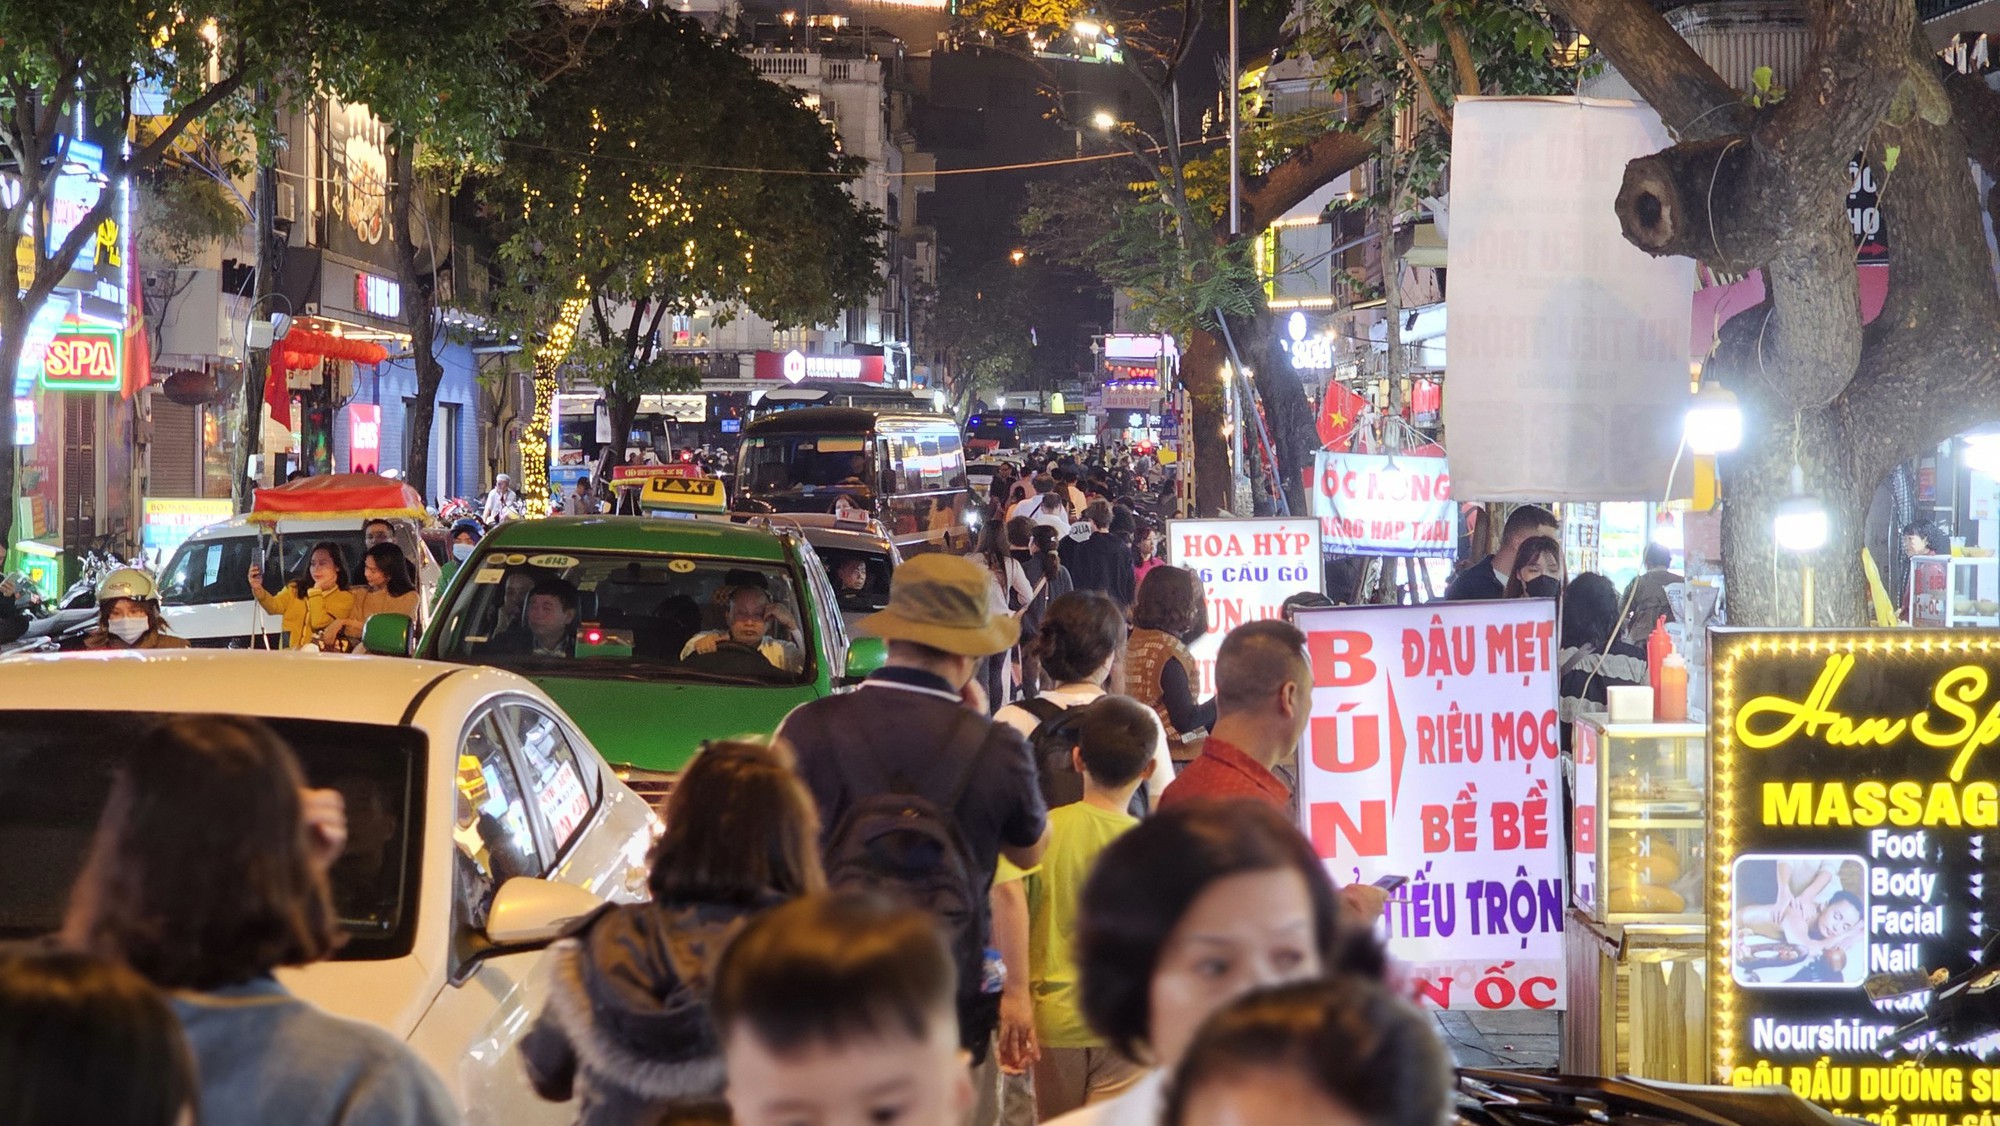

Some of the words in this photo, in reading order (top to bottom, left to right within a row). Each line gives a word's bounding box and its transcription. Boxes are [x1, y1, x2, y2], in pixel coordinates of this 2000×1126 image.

[46, 341, 116, 375] SPA
[1367, 473, 1450, 502] NG
[1183, 532, 1245, 558] HOA
[1221, 561, 1269, 583] CẦU
[1203, 588, 1244, 635] ÚN
[1401, 614, 1476, 691] ĐẬU
[1485, 620, 1555, 687] MẸT
[1307, 630, 1388, 859] BÚN
[1416, 701, 1484, 765] RIÊU
[1491, 708, 1560, 775] MỌC
[1420, 782, 1478, 854] BỀ
[1490, 779, 1549, 852] BỀ
[1763, 781, 1998, 828] MASSAG
[1871, 829, 1928, 859] Foot
[1465, 865, 1565, 950] TRỘN
[1871, 867, 1937, 903] Body
[1871, 905, 1945, 934] Facial
[1871, 943, 1921, 973] Nail
[1473, 960, 1559, 1010] ỐC
[1790, 1056, 1852, 1100] ĐẦU
[1859, 1059, 1964, 1102] DƯỠNG
[1971, 1066, 2000, 1101] S
